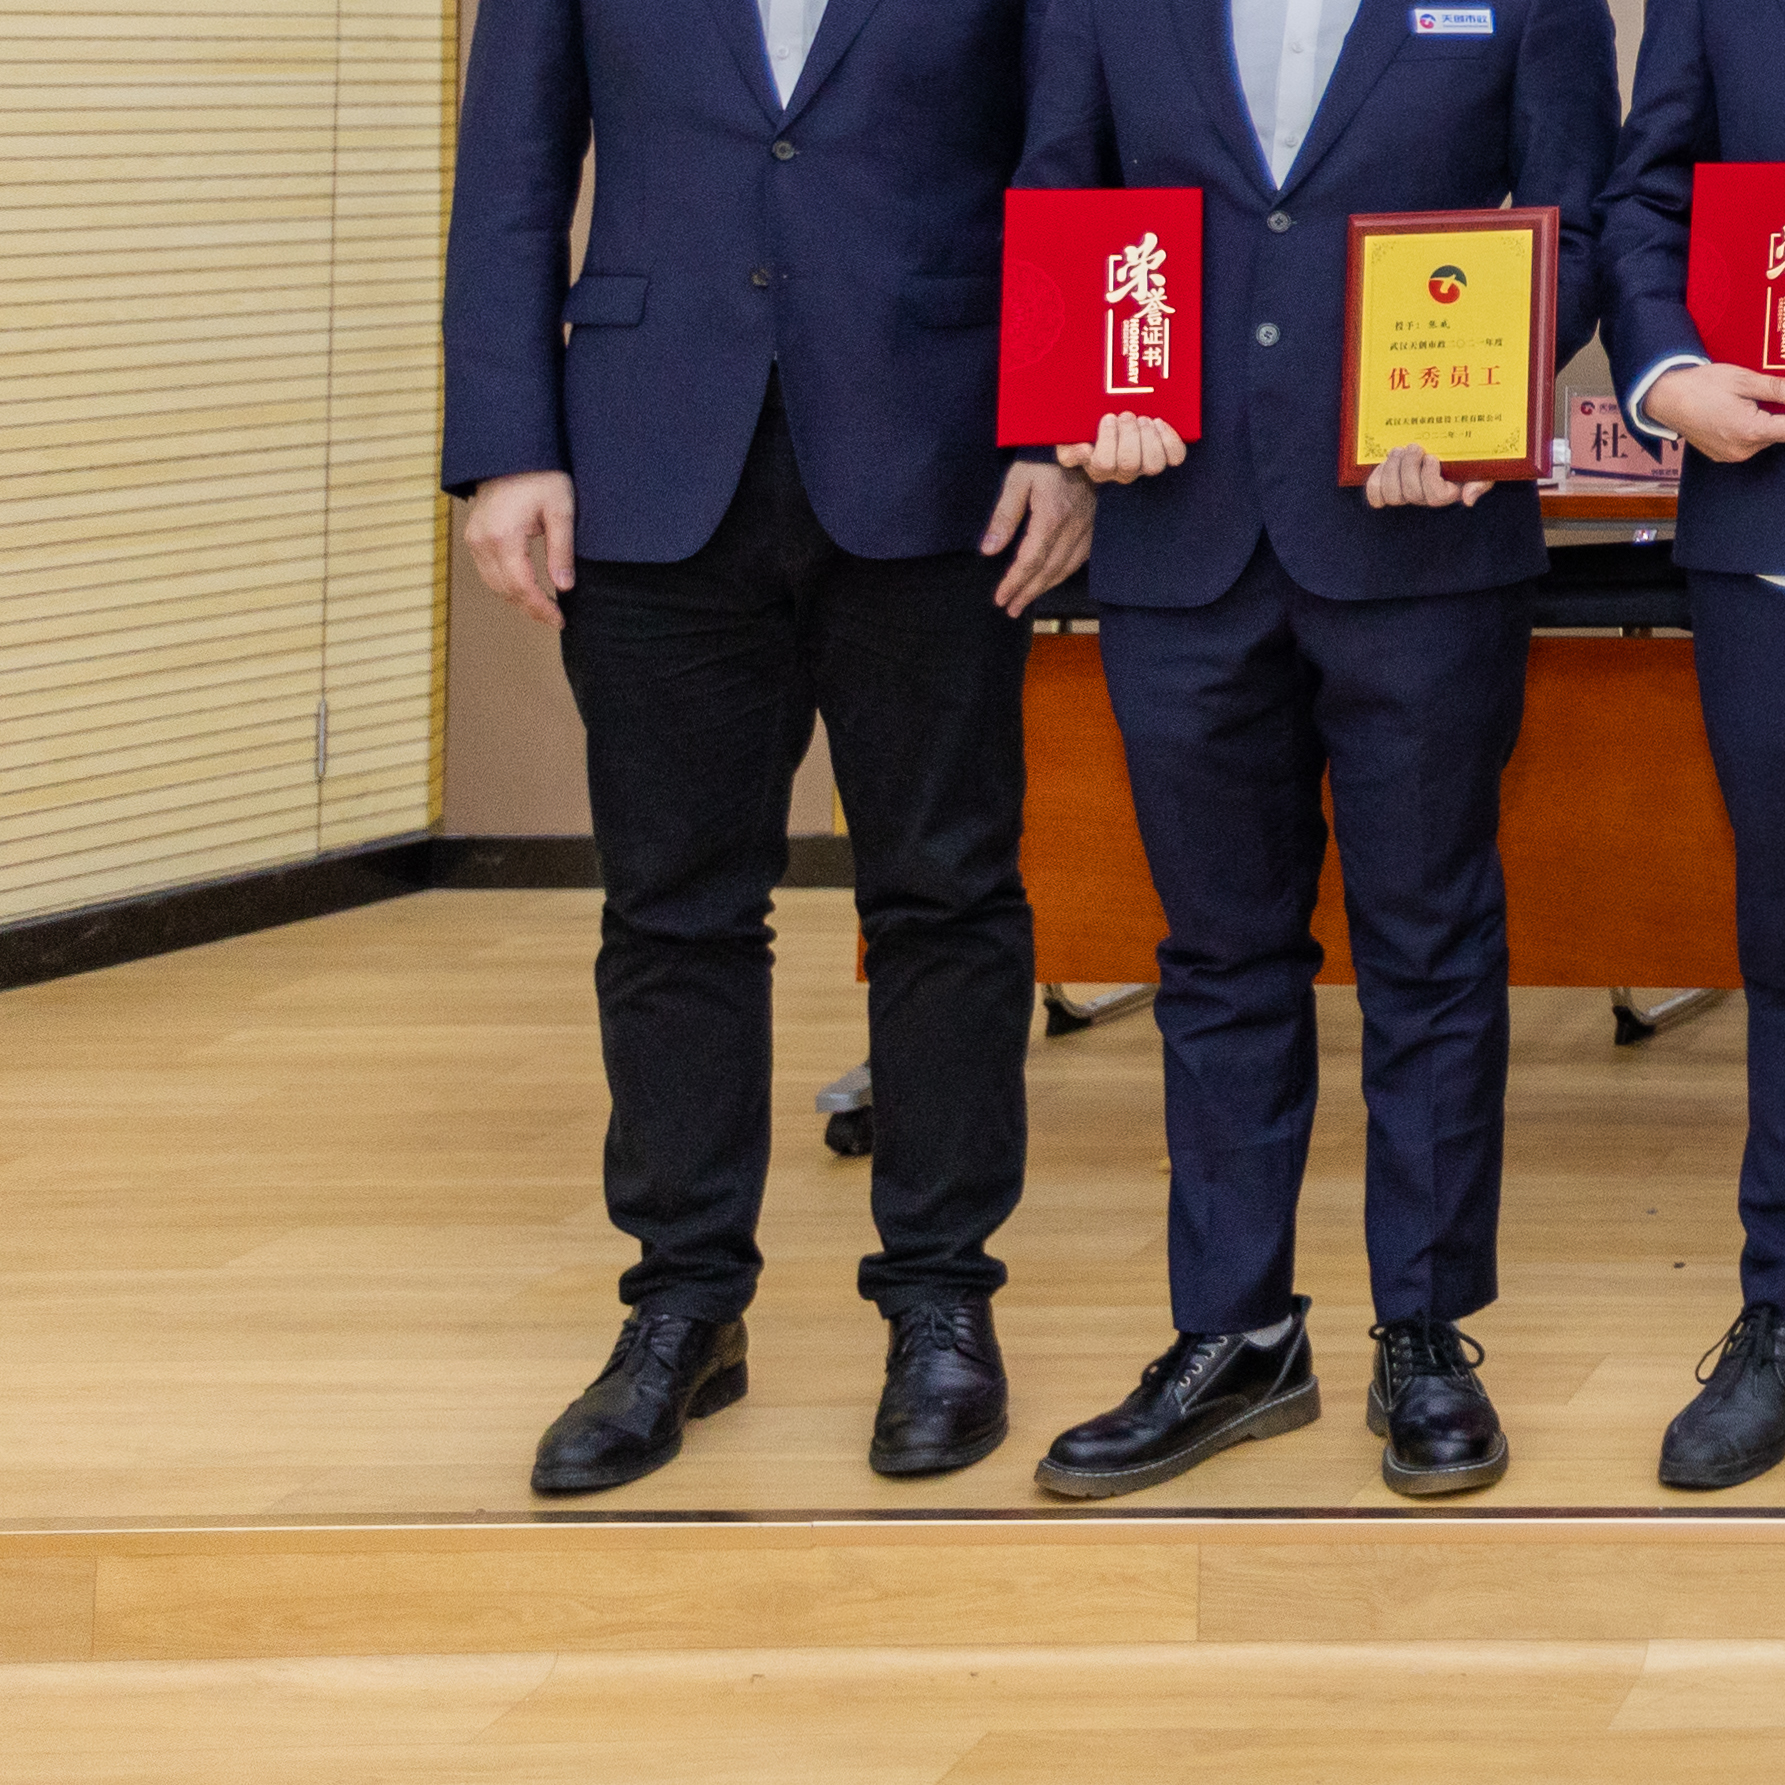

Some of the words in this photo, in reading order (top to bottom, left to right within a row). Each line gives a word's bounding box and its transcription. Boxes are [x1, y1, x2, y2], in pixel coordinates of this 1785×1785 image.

[1105, 232, 1176, 368] 荣誉证书
[1128, 318, 1140, 384] HONORARY
[1388, 365, 1501, 391] 优秀员工
